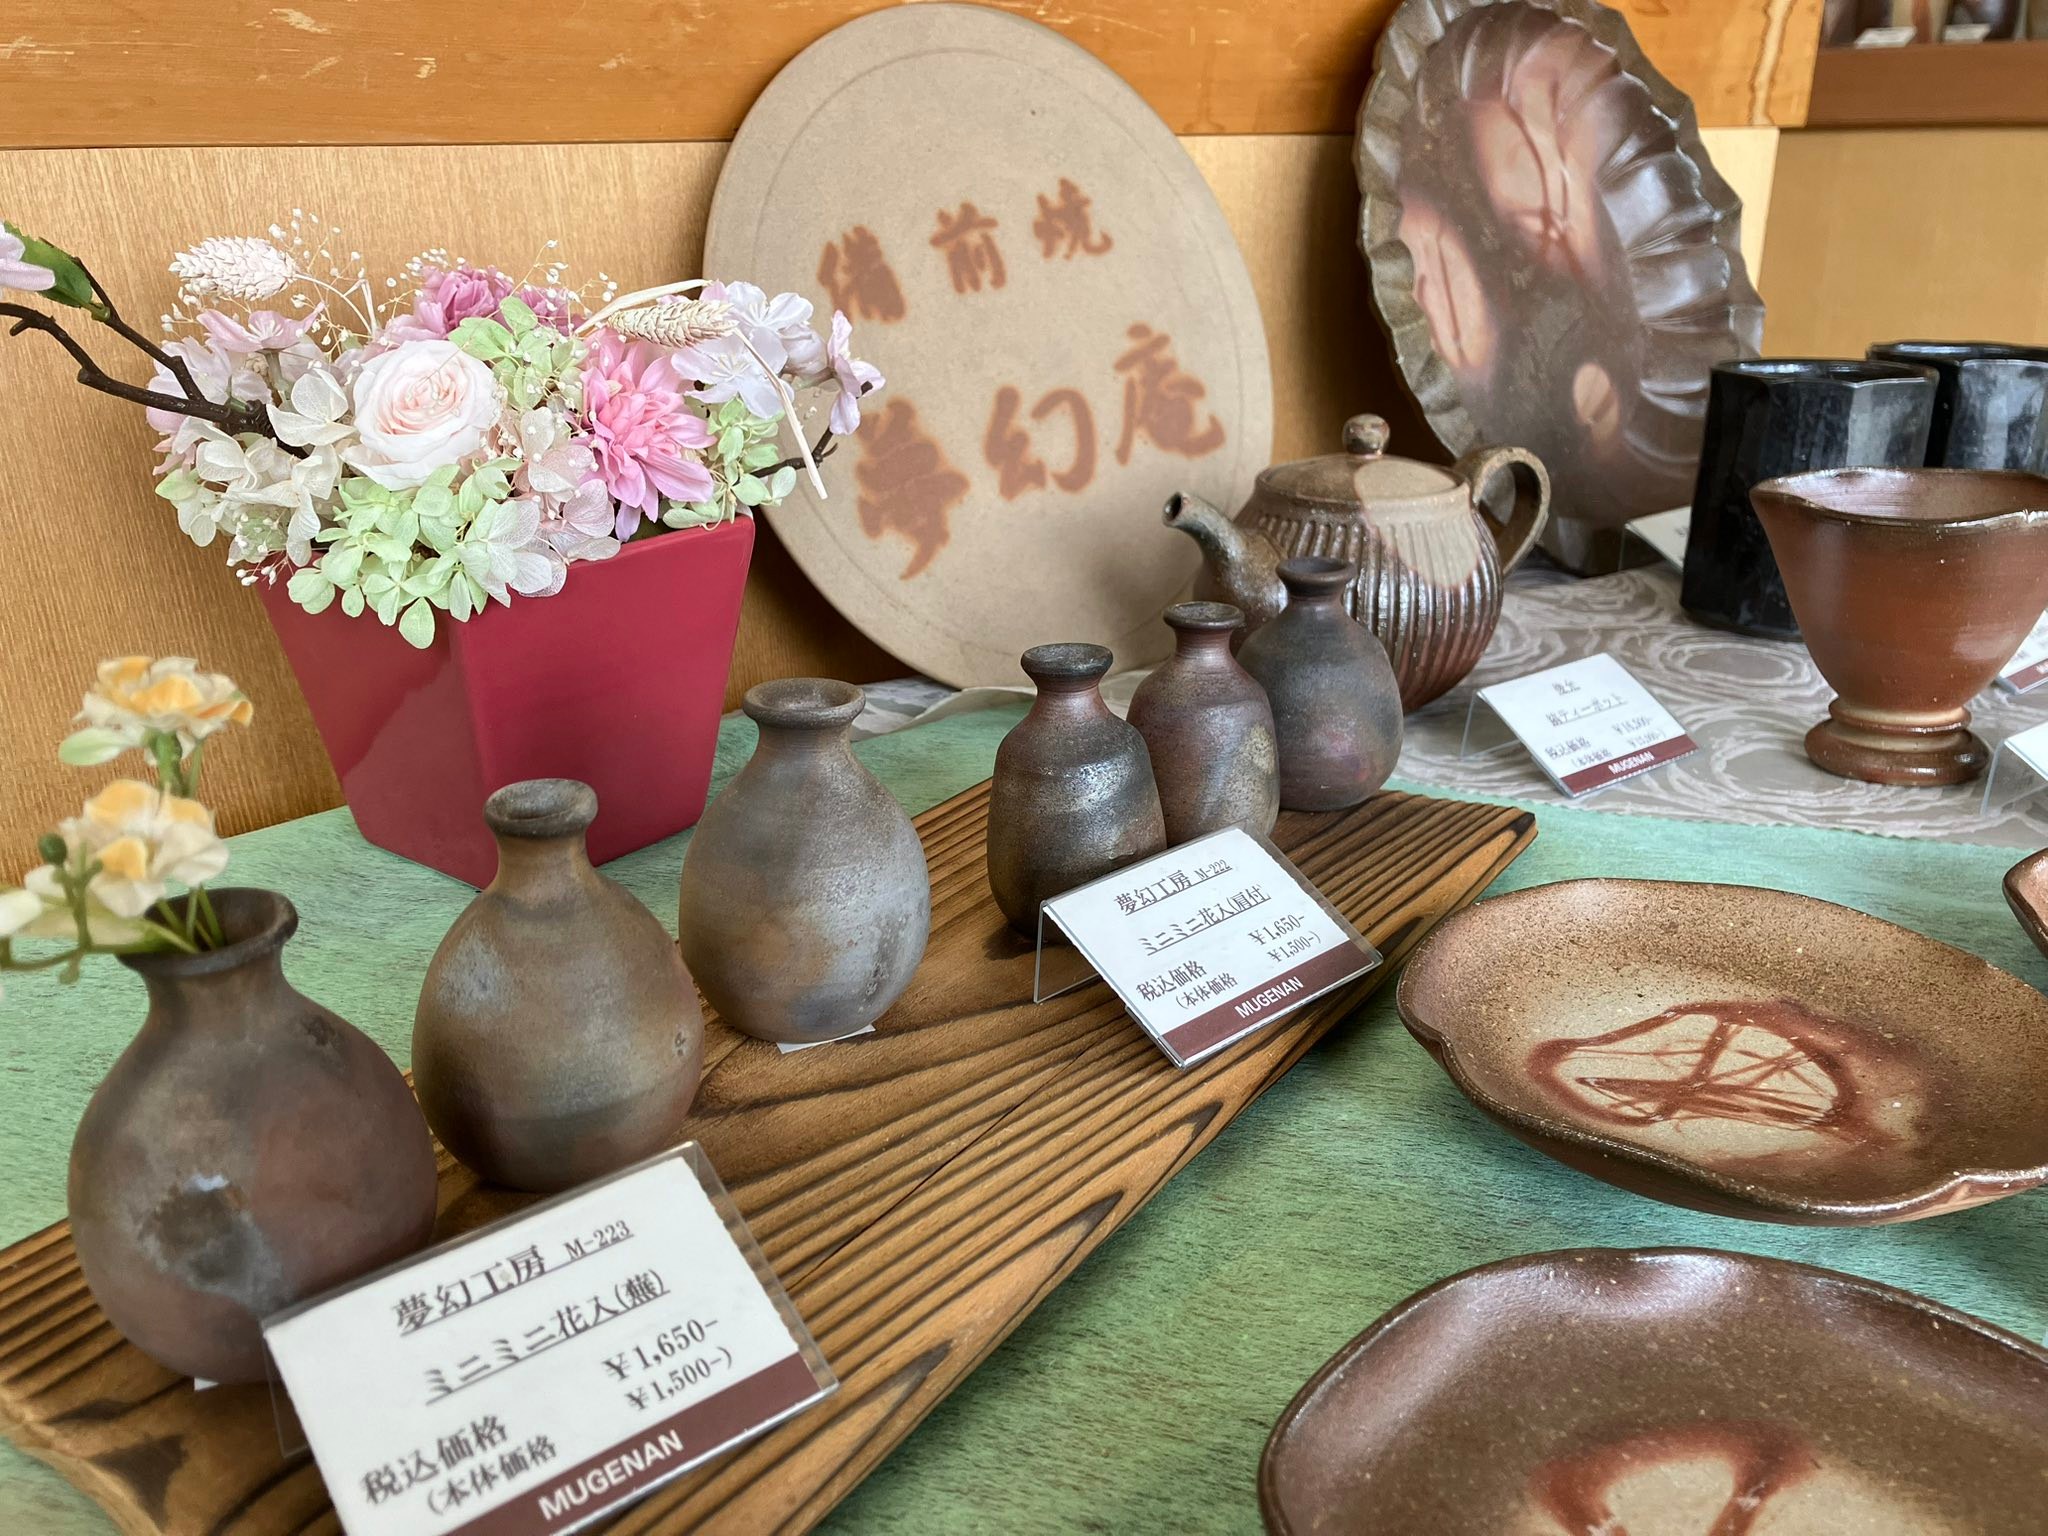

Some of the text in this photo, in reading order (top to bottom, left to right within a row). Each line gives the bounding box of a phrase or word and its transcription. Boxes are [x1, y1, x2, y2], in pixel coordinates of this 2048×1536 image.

[1114, 859, 1232, 914] 夢幻工房 M-222
[1136, 959, 1207, 1002] 税込価格
[1176, 972, 1238, 1010] (本体価格
[1234, 976, 1304, 1019] MUGENAN
[392, 1219, 632, 1331] 夢幻工房 M-223
[360, 1415, 508, 1508] 税込価格
[426, 1435, 559, 1515] (本体価格
[537, 1430, 684, 1521] MUGENAN
